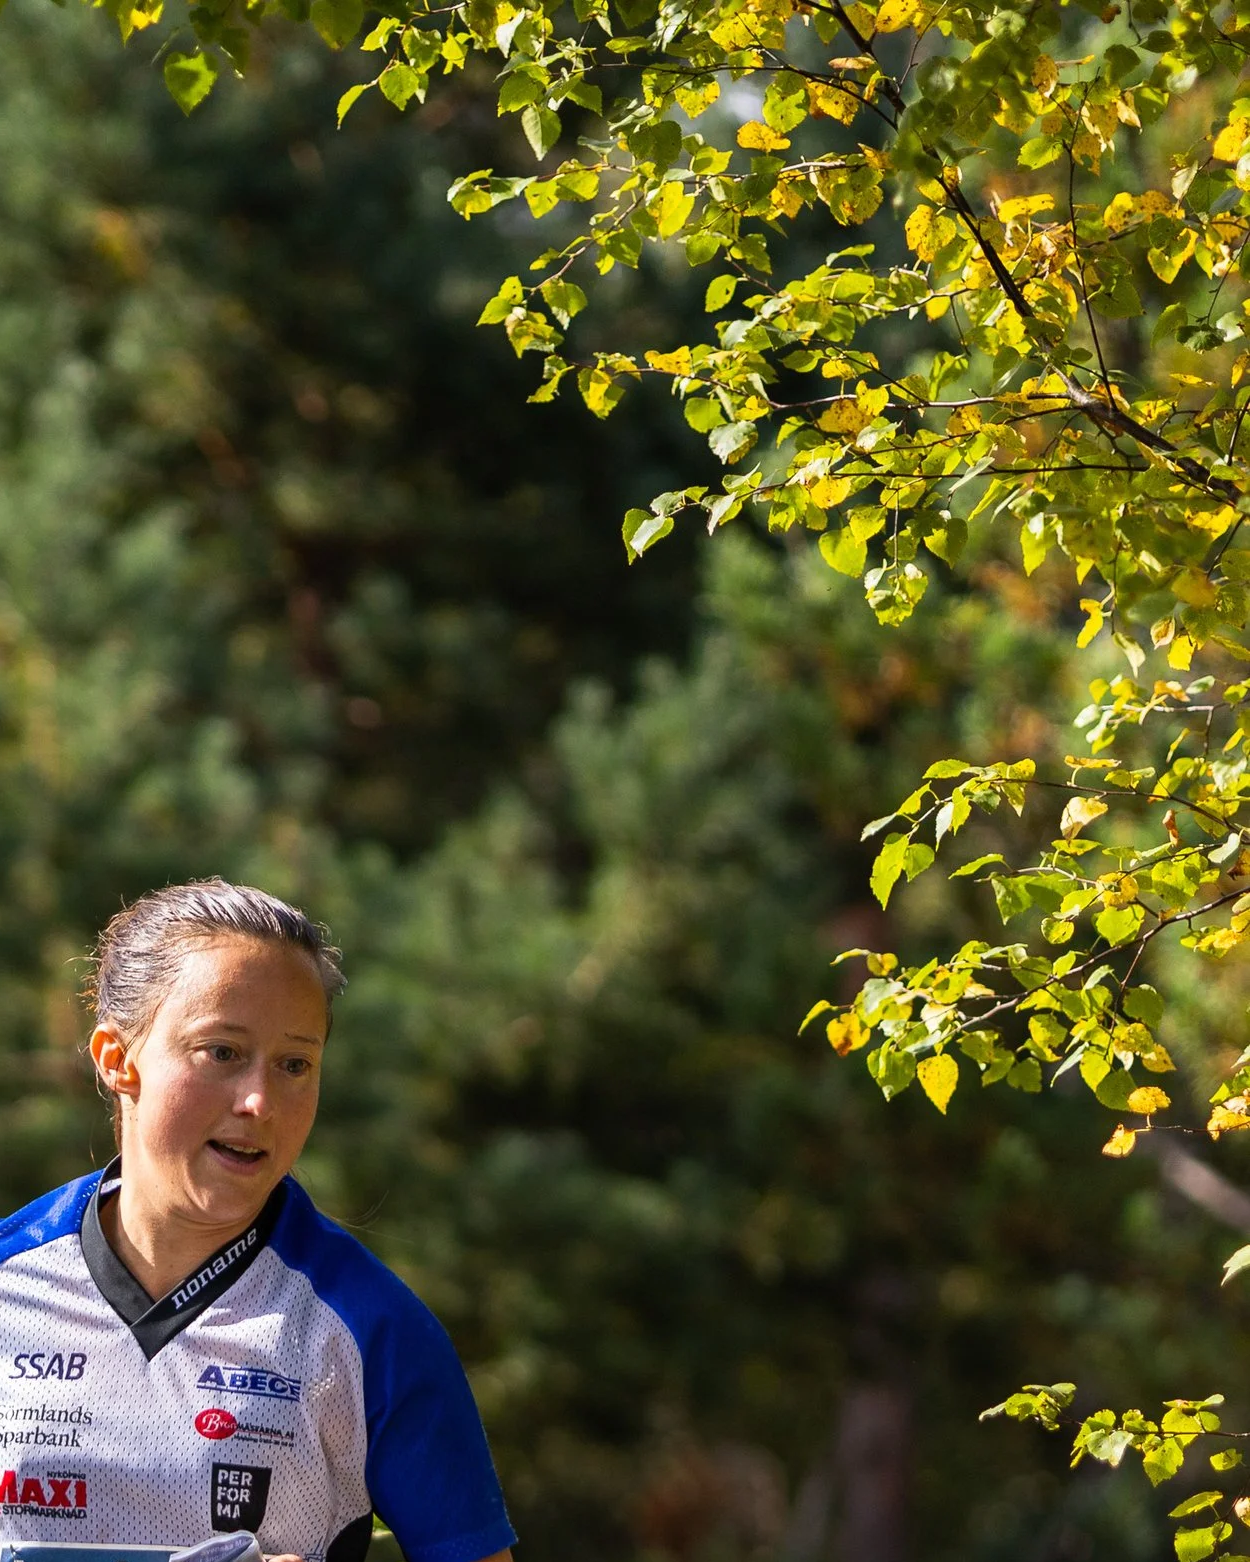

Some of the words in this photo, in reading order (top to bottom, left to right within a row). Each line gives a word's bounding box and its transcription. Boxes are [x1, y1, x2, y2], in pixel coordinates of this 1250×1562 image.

[171, 1228, 257, 1310] noname
[8, 1352, 88, 1381] SSAB
[217, 1469, 253, 1487] PER
[216, 1486, 251, 1503] FOR
[2, 1504, 88, 1519] STORMARKNAD
[216, 1502, 241, 1519] MA
